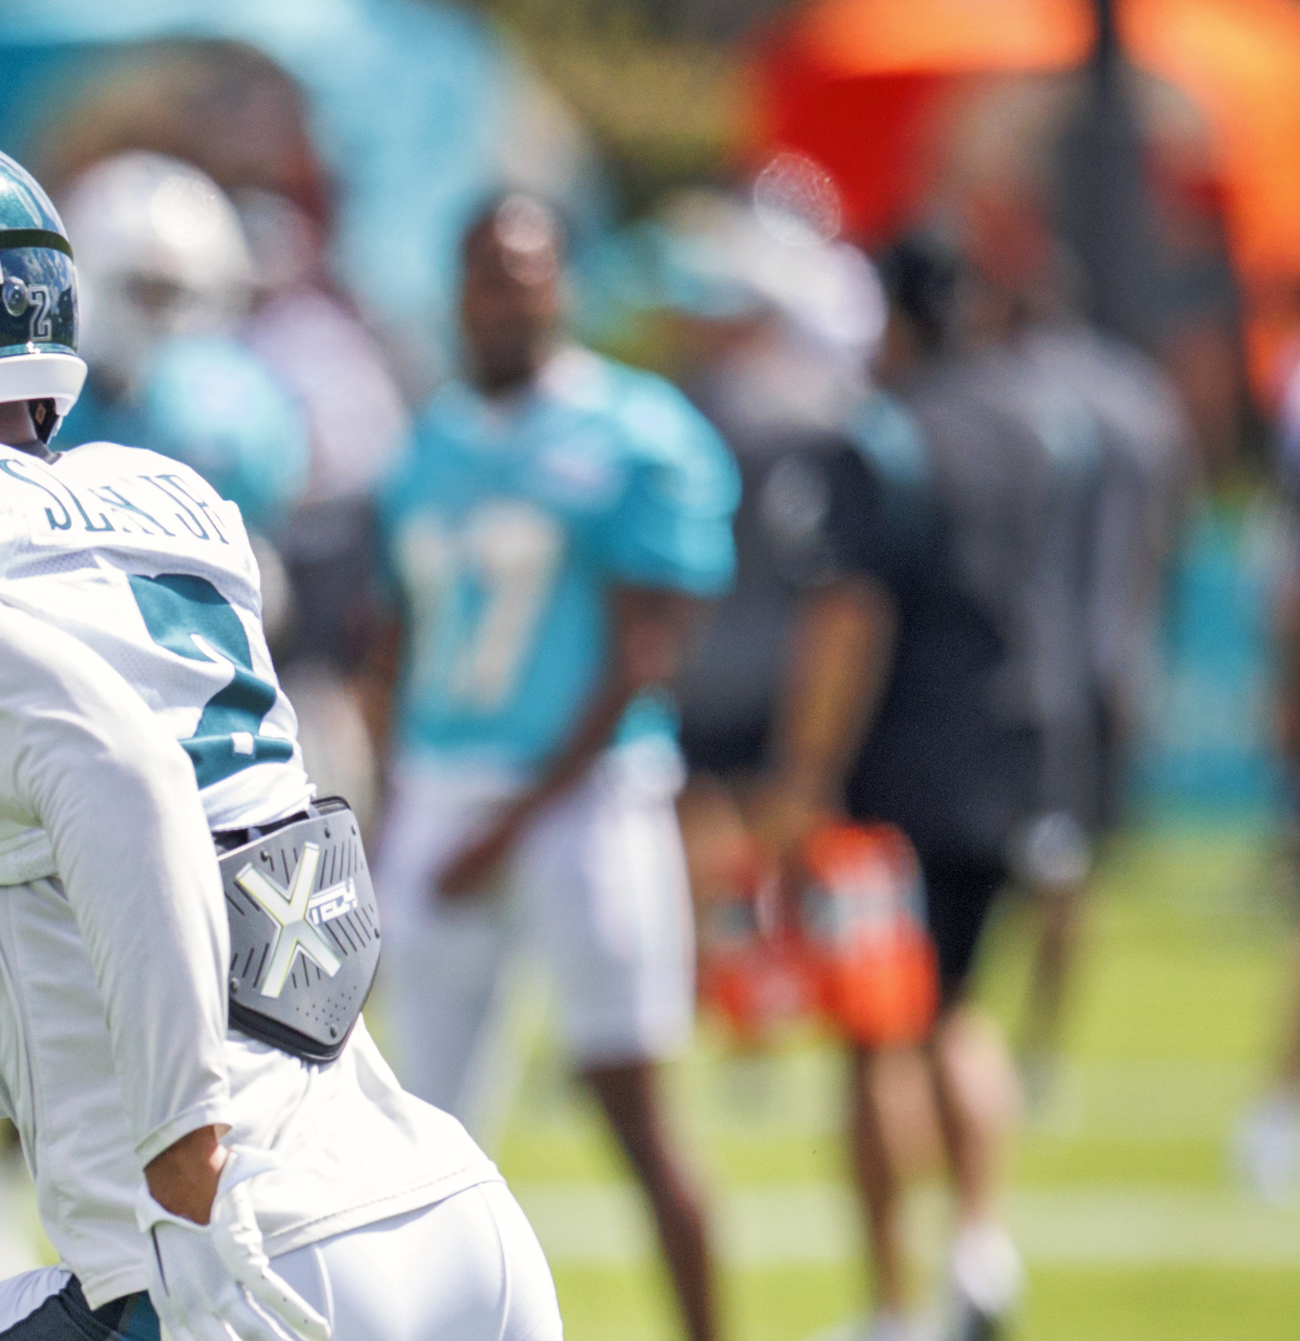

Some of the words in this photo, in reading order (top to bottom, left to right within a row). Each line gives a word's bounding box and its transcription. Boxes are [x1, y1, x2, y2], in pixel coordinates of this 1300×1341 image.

[28, 284, 52, 341] 2
[125, 573, 295, 791] 2
[390, 497, 568, 715] 17
